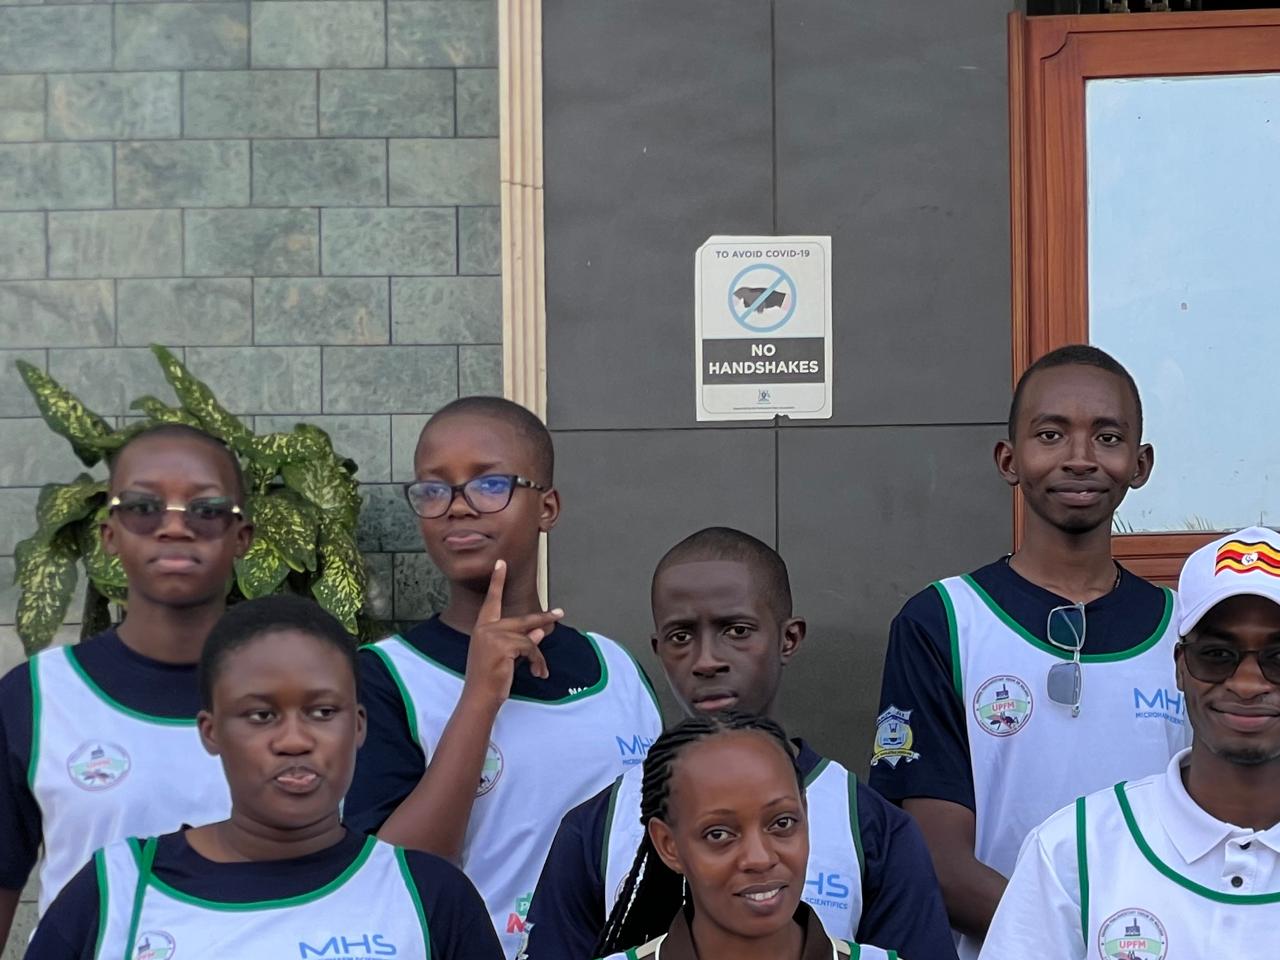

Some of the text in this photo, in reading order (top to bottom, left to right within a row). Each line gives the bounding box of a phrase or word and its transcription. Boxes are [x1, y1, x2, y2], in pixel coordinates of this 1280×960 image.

[715, 249, 810, 258] TO AVOID COVID-19
[751, 344, 776, 357] NO
[709, 360, 819, 375] HANDSHAKES
[1133, 687, 1185, 715] MH
[805, 872, 849, 898] HS
[299, 934, 397, 959] MHS
[1119, 940, 1146, 949] UPFM
